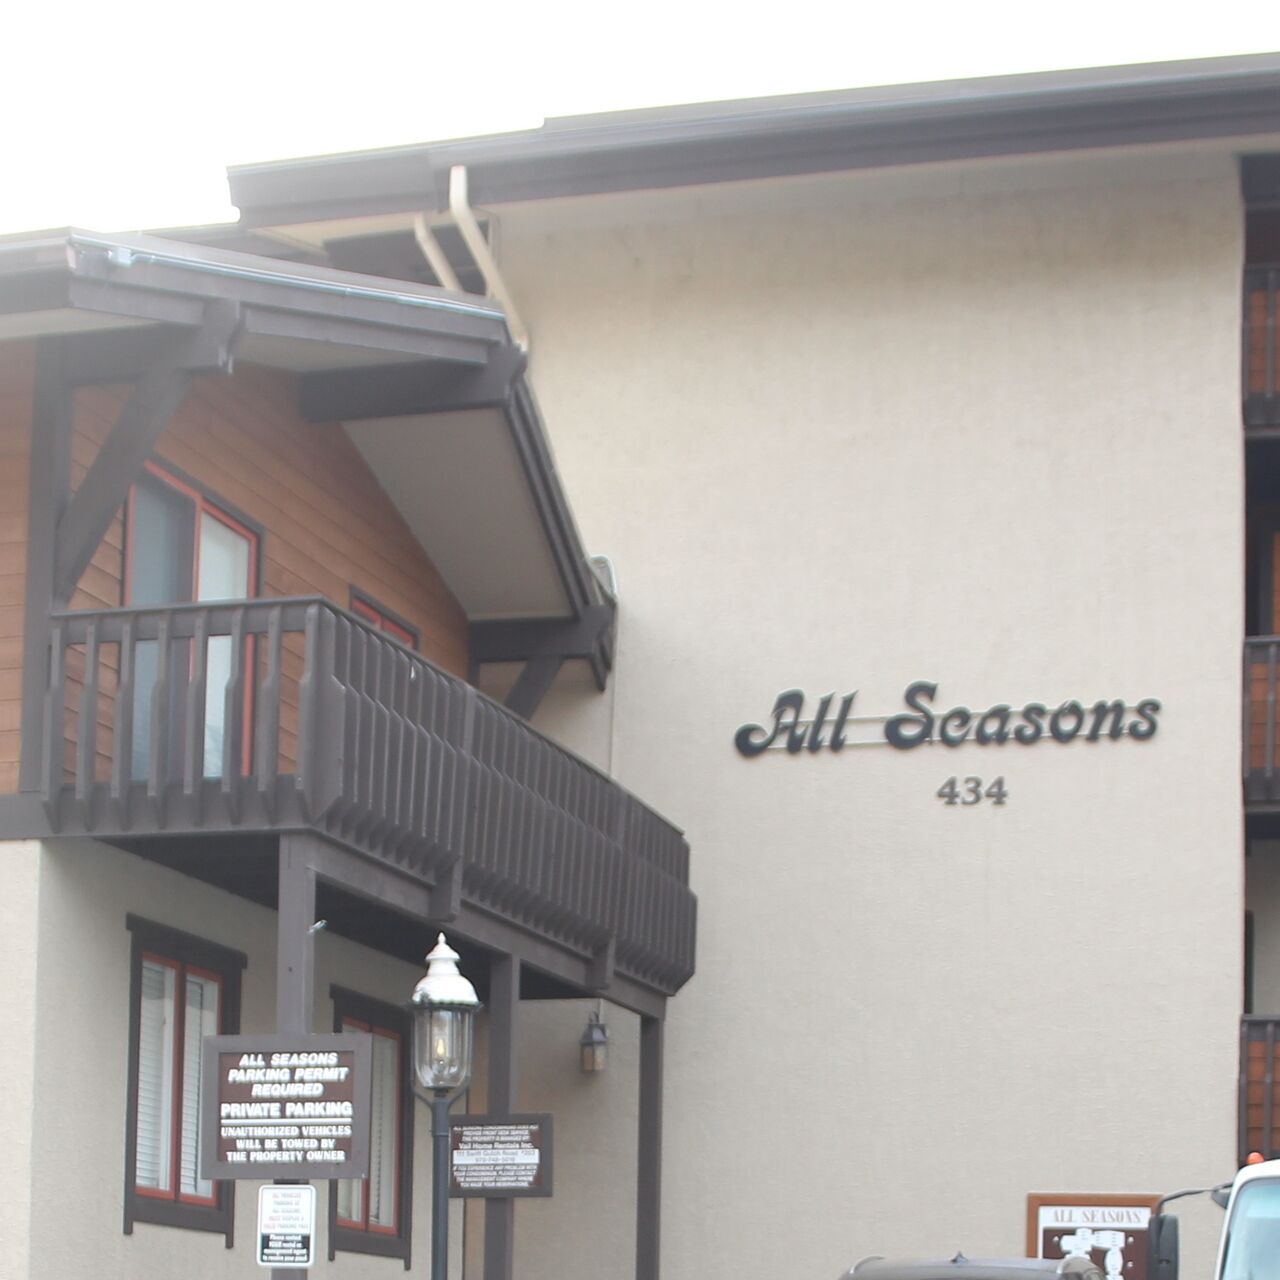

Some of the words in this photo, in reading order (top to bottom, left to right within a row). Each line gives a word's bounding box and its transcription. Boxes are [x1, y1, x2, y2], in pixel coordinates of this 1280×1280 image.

[733, 688, 859, 758] All
[884, 679, 1163, 750] Seasons
[938, 776, 1008, 805] 434
[239, 1054, 265, 1067] ALL
[271, 1052, 338, 1066] SEASONS
[228, 1068, 290, 1083] PARKING
[294, 1068, 349, 1081] PERMIT
[251, 1083, 323, 1097] REQUIRED
[221, 1103, 280, 1118] PRIVATE
[286, 1102, 352, 1116] PARKING
[221, 1126, 298, 1137] UNAUTHORIZED
[302, 1126, 351, 1137] VEHICLES
[236, 1139, 262, 1149] WILL
[264, 1139, 278, 1149] BE
[282, 1139, 318, 1149] TOWED
[321, 1139, 336, 1149] BY
[226, 1152, 246, 1162] THE
[250, 1152, 304, 1162] PROPERTY
[307, 1151, 345, 1161] OWNER
[1053, 1210, 1074, 1222] ALL
[1082, 1209, 1142, 1224] SEASONS
